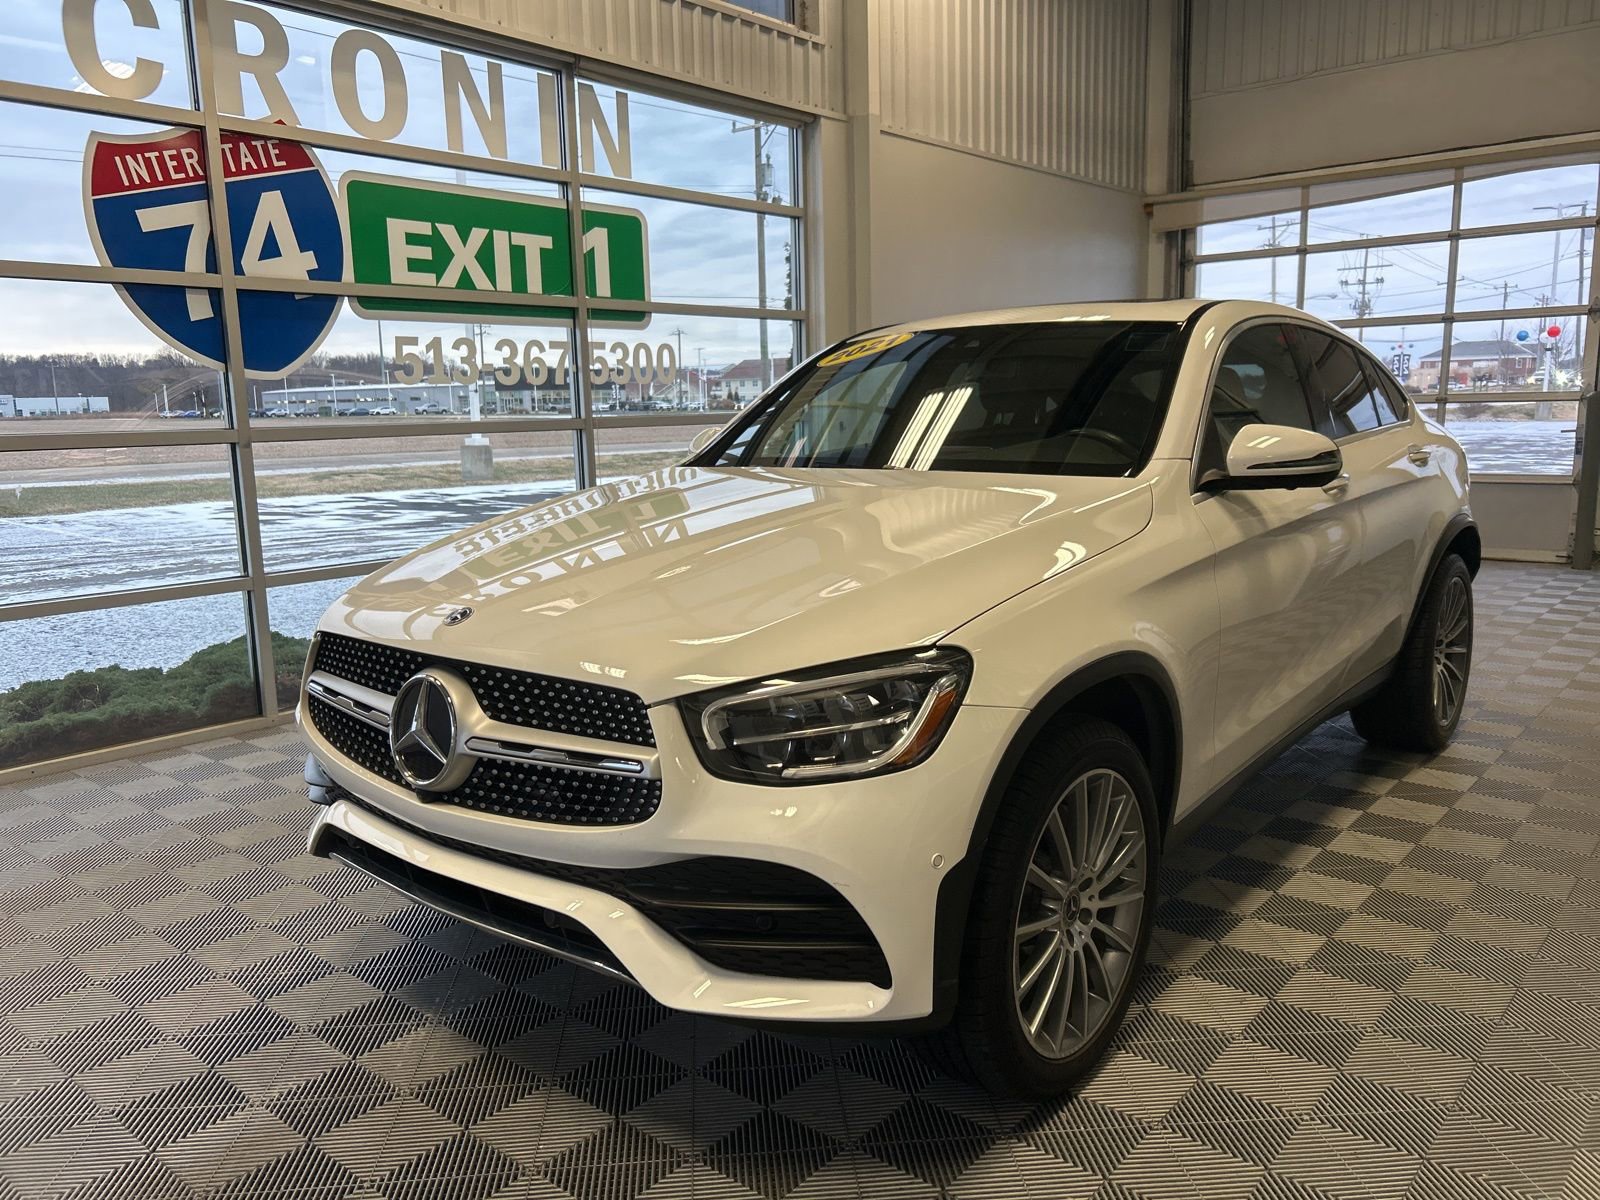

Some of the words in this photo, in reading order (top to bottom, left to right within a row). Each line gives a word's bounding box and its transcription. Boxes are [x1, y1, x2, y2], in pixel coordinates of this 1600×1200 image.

[62, 0, 631, 179] CRONIN
[114, 139, 287, 186] INTERTATE
[135, 190, 319, 321] 74
[386, 217, 553, 295] EXIT
[582, 226, 612, 298] 1
[394, 334, 677, 387] 513-3675300
[830, 335, 897, 361] 2021
